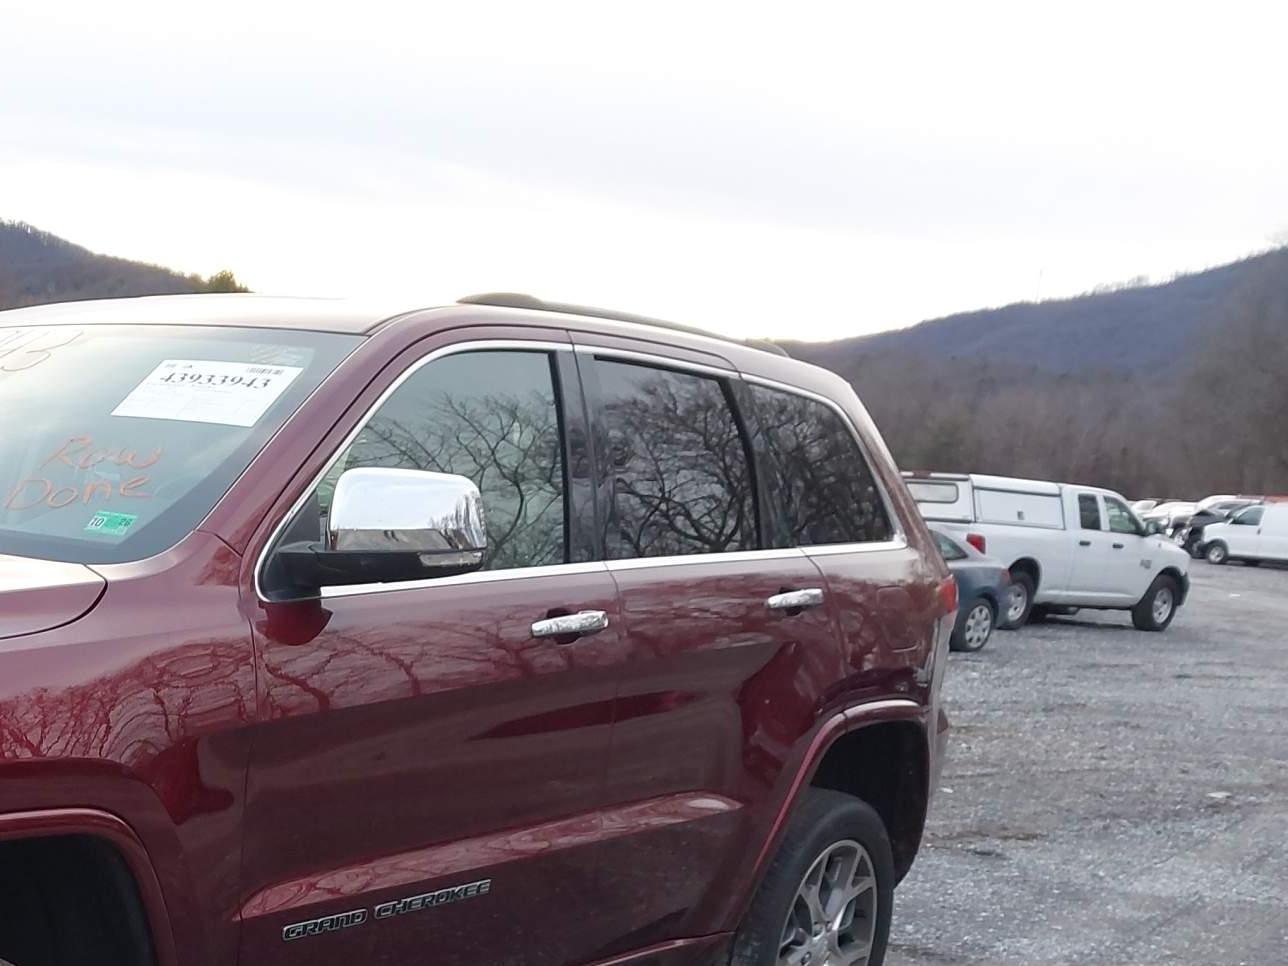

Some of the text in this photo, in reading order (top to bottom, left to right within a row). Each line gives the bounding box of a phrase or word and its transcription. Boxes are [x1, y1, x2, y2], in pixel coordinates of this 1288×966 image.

[158, 372, 272, 390] 43933943
[90, 517, 105, 527] 10
[282, 879, 492, 941] GRAND CHEROKEE
